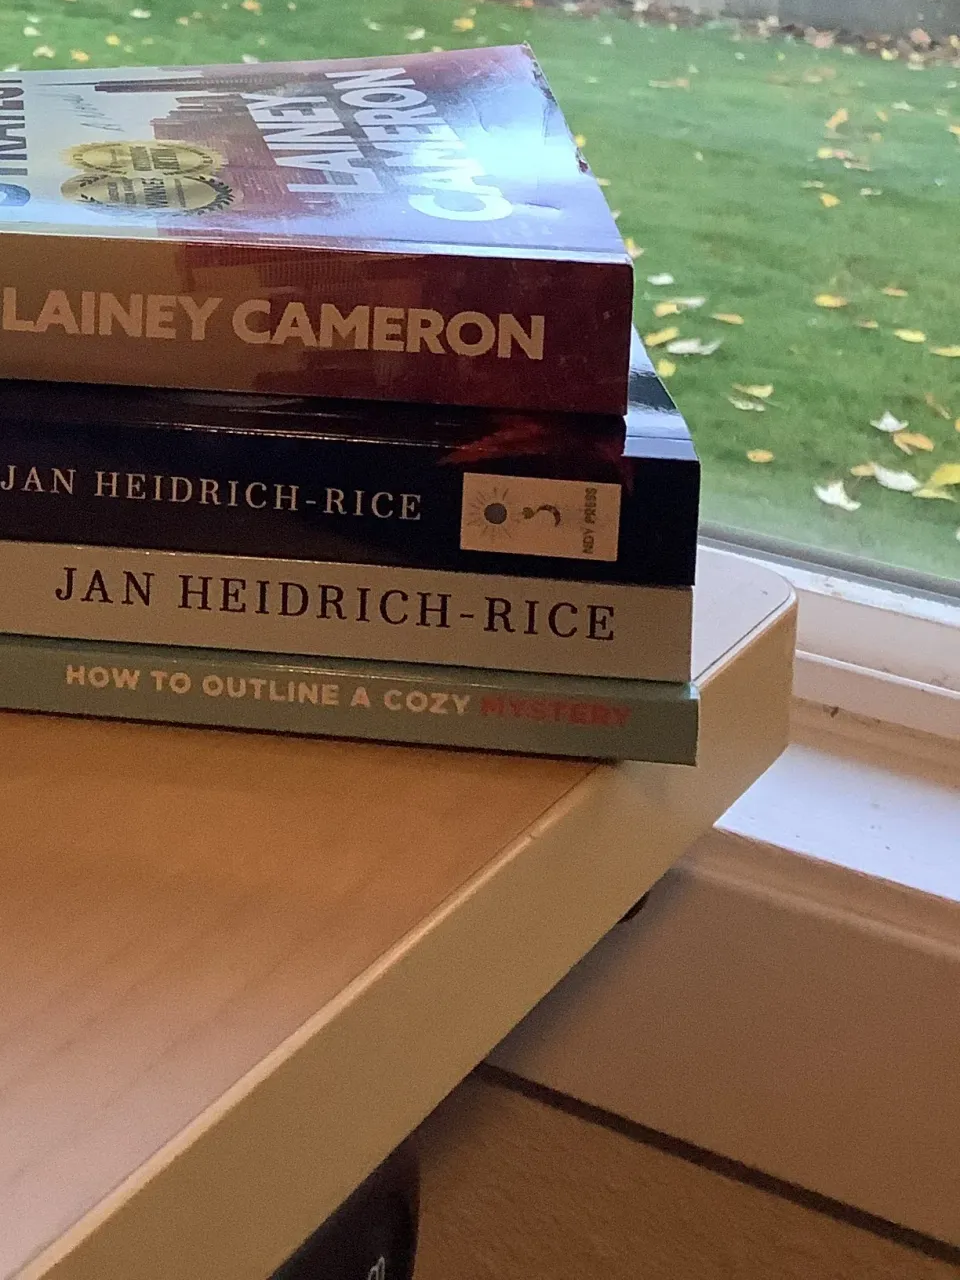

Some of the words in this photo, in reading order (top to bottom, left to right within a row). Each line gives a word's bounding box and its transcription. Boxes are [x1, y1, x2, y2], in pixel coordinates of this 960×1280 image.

[240, 92, 385, 194] LAINEY
[324, 67, 514, 221] CAMERON
[1, 286, 222, 341] LAINEY
[232, 298, 546, 361] CAMERON
[0, 464, 76, 495] JAN
[95, 470, 423, 522] HEIDRICH-RICE
[583, 487, 598, 525] PRESS
[55, 567, 154, 606] JAN
[178, 574, 617, 642] HEIDRICH-RICE
[66, 664, 140, 691] HOW
[150, 670, 191, 694] TO
[202, 675, 340, 705] OUTLINE
[350, 686, 371, 708] A
[384, 689, 471, 716] COZY
